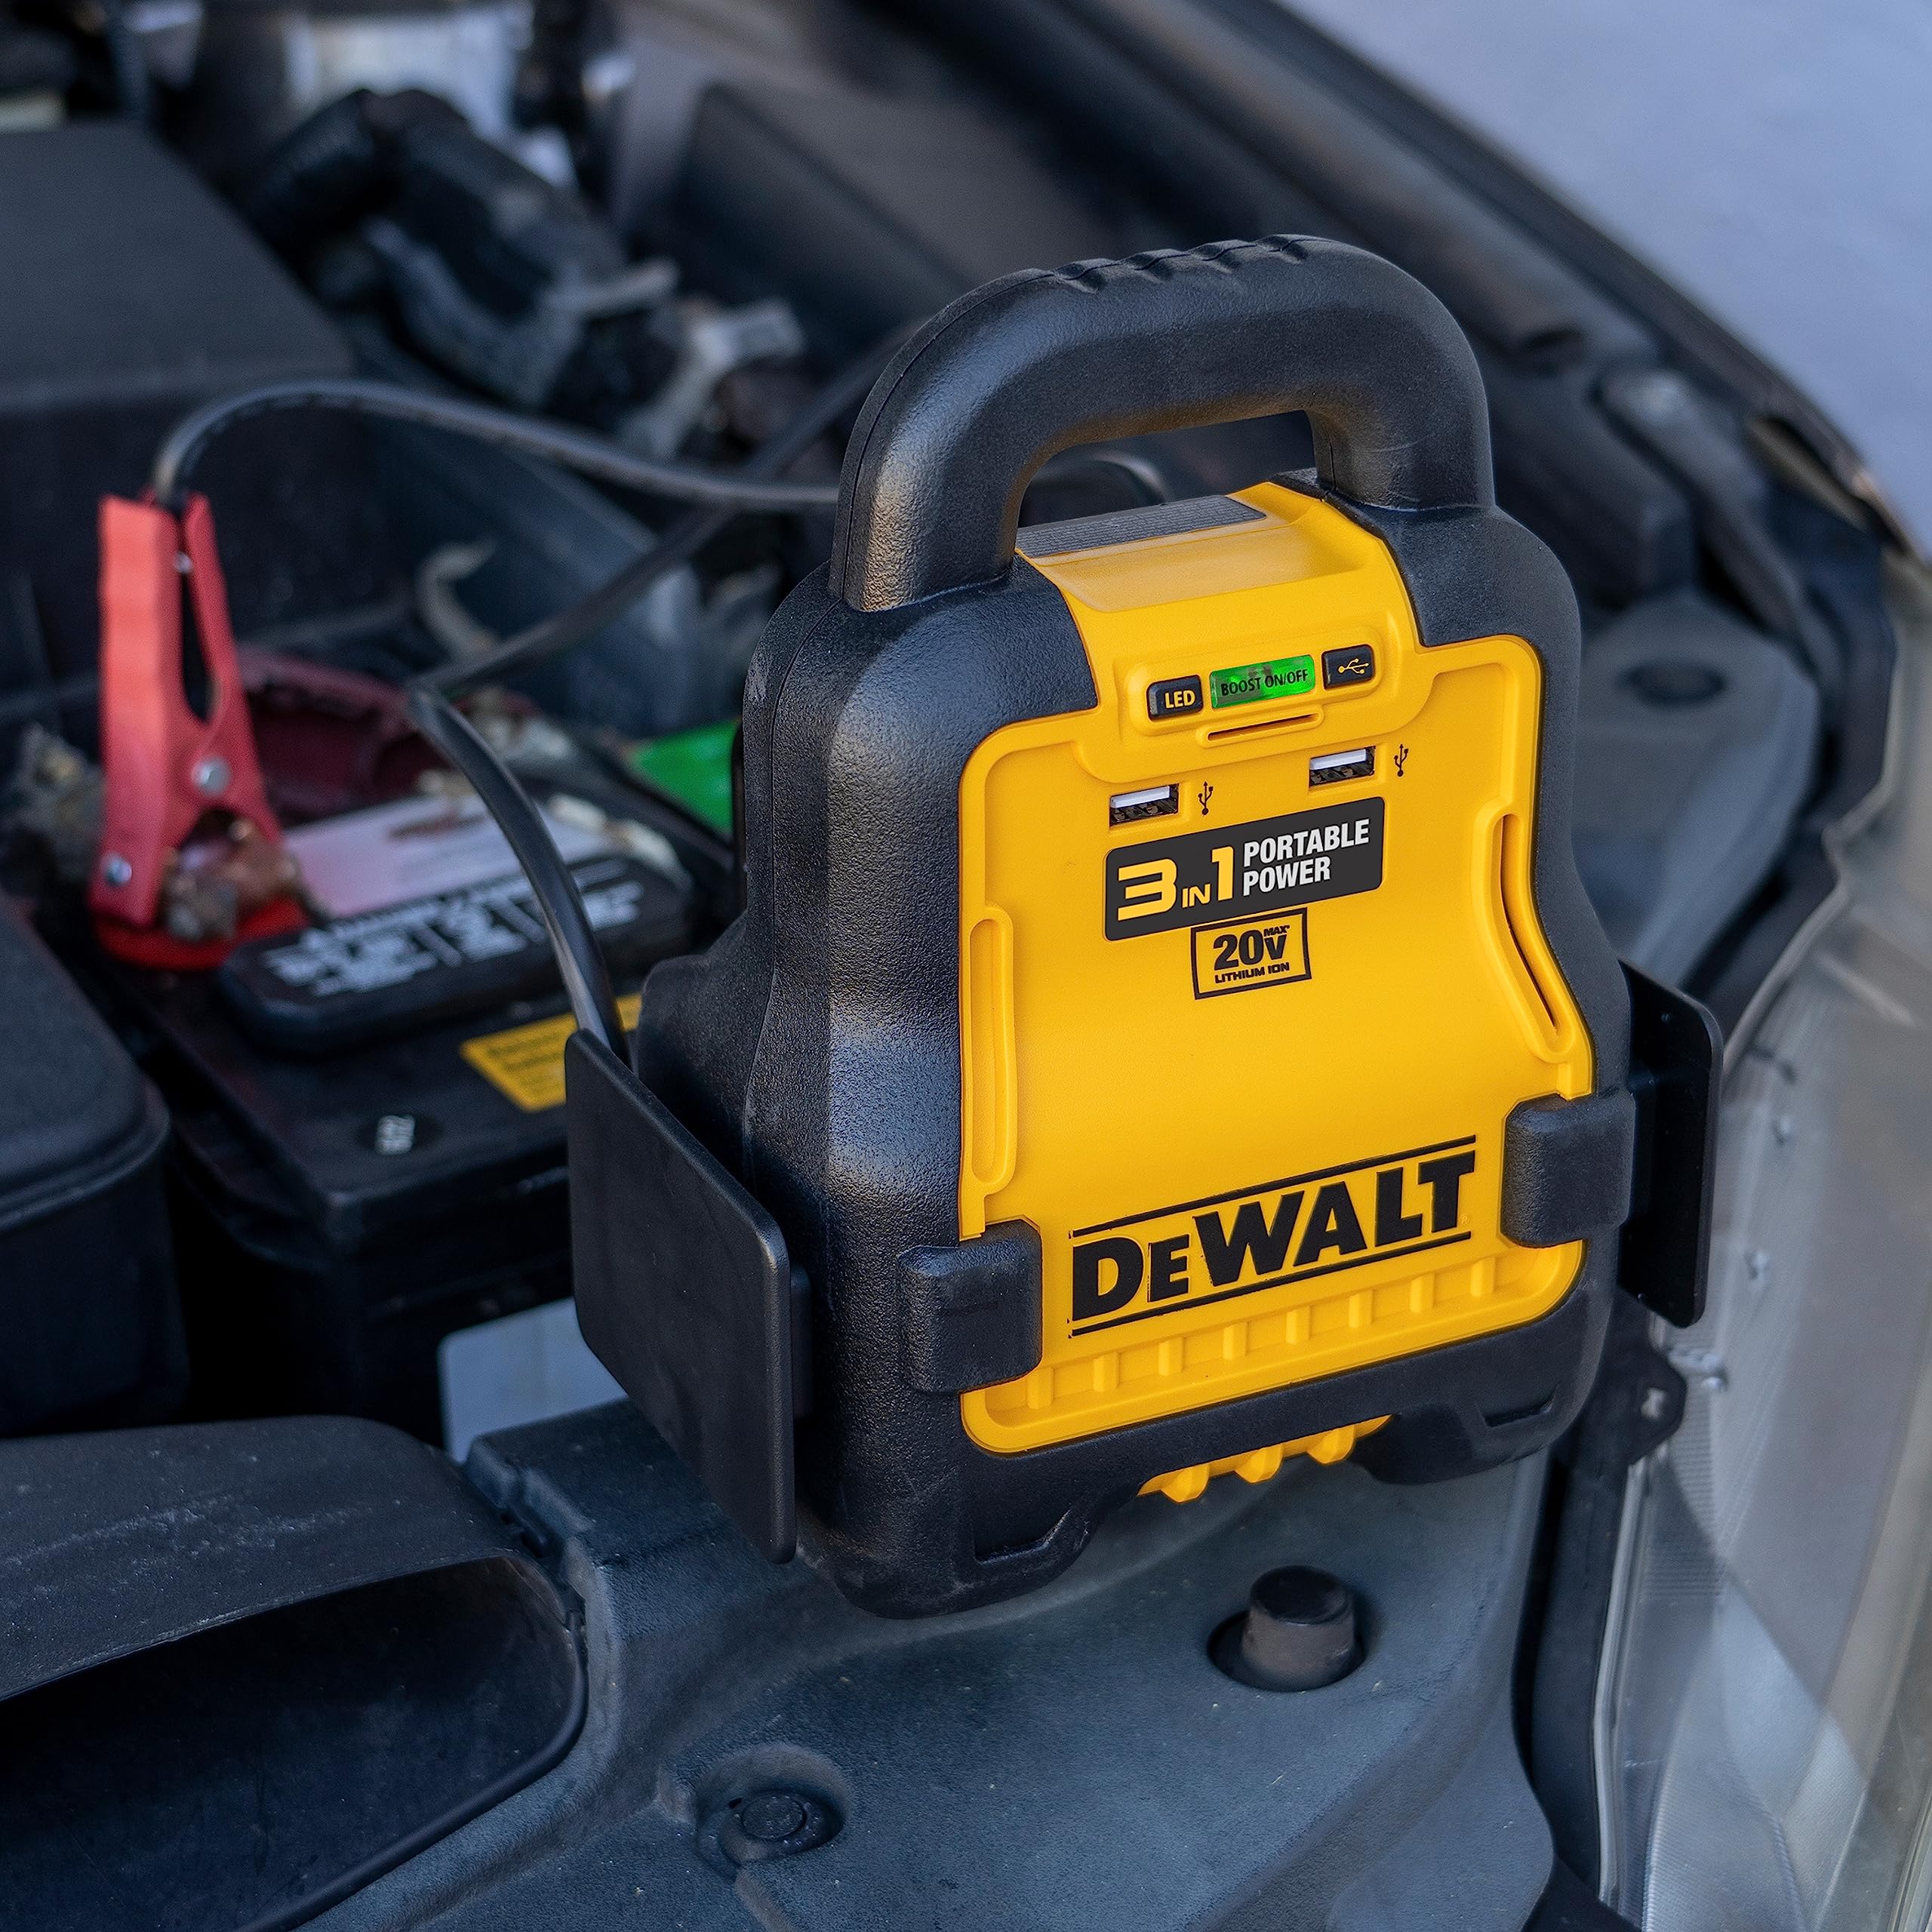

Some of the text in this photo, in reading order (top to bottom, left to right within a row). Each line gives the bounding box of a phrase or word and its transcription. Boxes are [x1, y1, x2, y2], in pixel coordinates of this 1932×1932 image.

[1164, 690, 1195, 709] LED
[1220, 669, 1309, 697] BOOST ON/OFF
[1243, 819, 1370, 867] PORTABLE
[1118, 846, 1234, 921] 3 IN 1
[1243, 856, 1331, 897] POWER
[1214, 962, 1290, 983] LITHIUM ION
